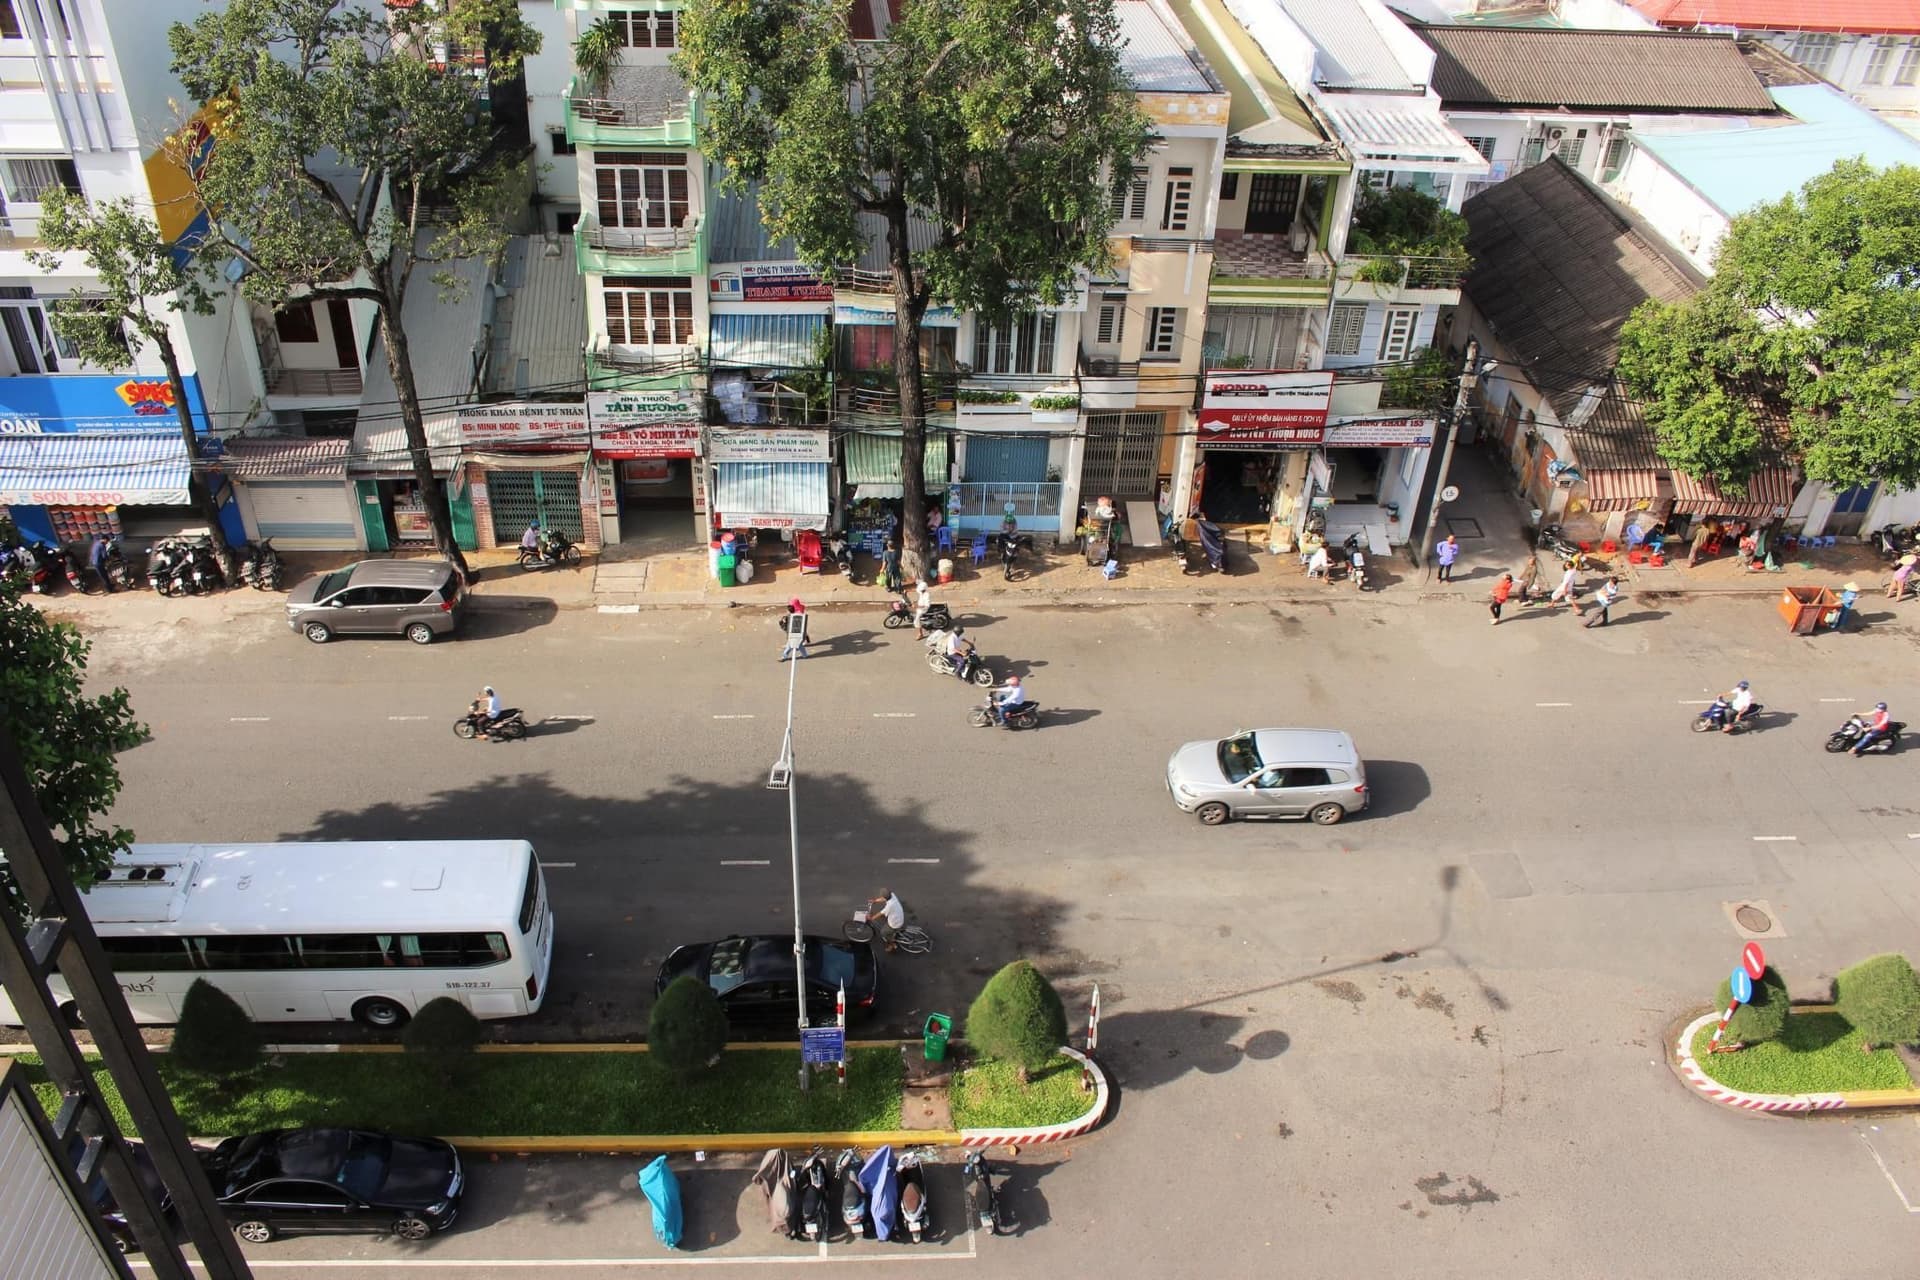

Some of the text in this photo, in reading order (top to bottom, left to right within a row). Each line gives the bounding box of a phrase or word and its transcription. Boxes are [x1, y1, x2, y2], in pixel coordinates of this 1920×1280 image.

[745, 287, 790, 297] THANH
[605, 402, 633, 412] TÂN
[476, 423, 497, 431] MINH
[499, 423, 520, 432] NGỌC
[650, 430, 676, 439] MINH
[678, 429, 698, 438] TÂN
[75, 492, 125, 503] EXPO
